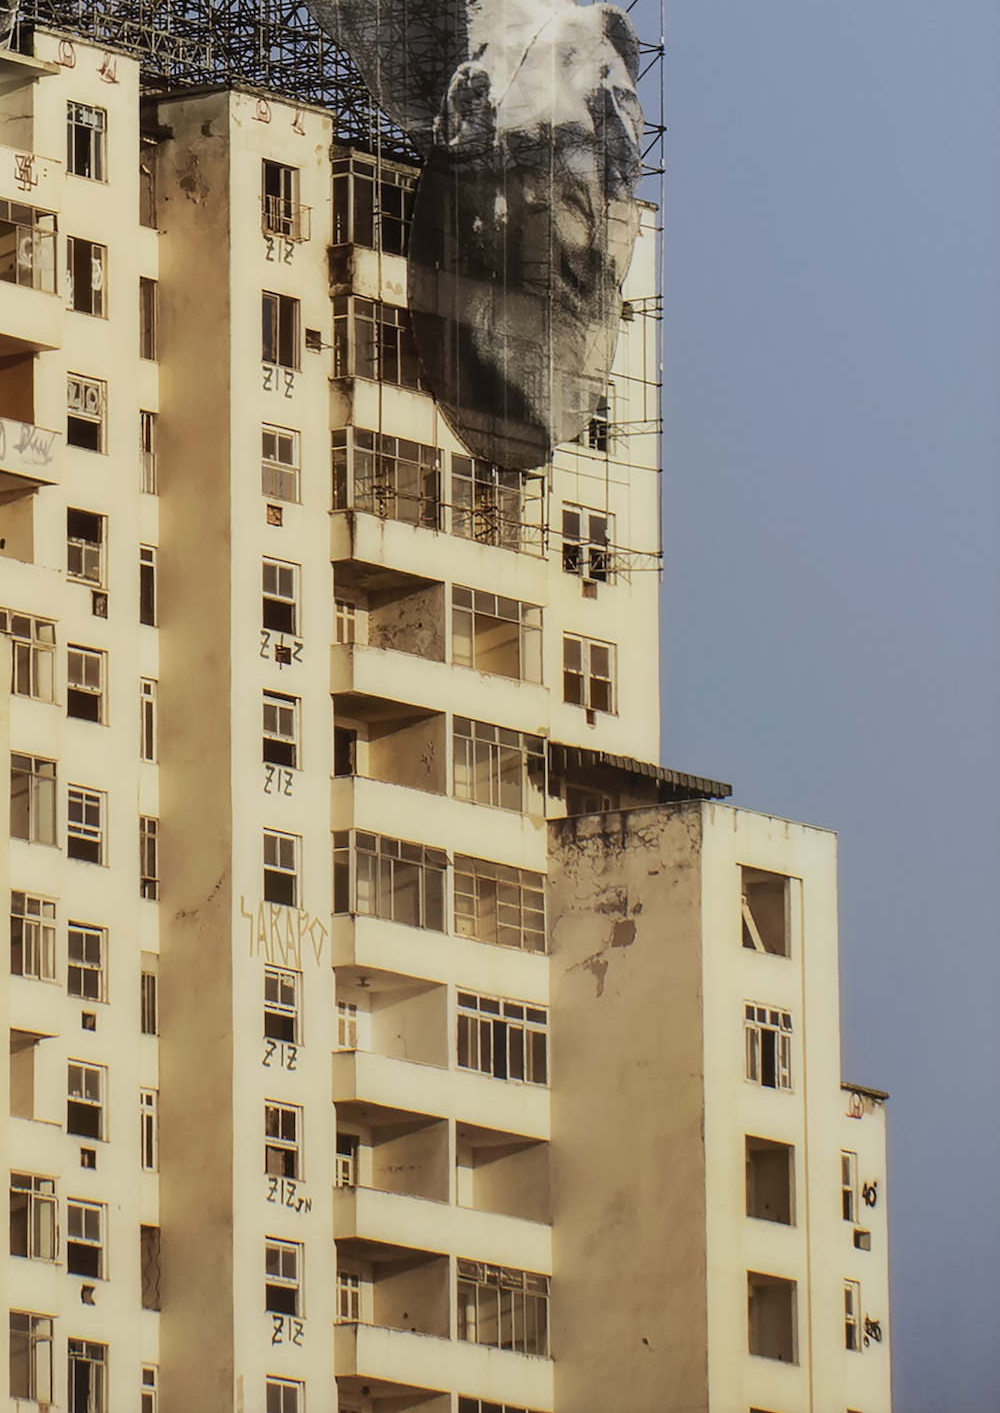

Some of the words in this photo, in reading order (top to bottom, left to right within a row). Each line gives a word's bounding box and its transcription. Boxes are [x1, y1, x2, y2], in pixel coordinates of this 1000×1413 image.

[262, 365, 295, 399] ZIZ
[264, 763, 294, 797] ZIZ
[262, 1040, 298, 1071] ZIZ
[271, 1314, 305, 1348] ZIZ
